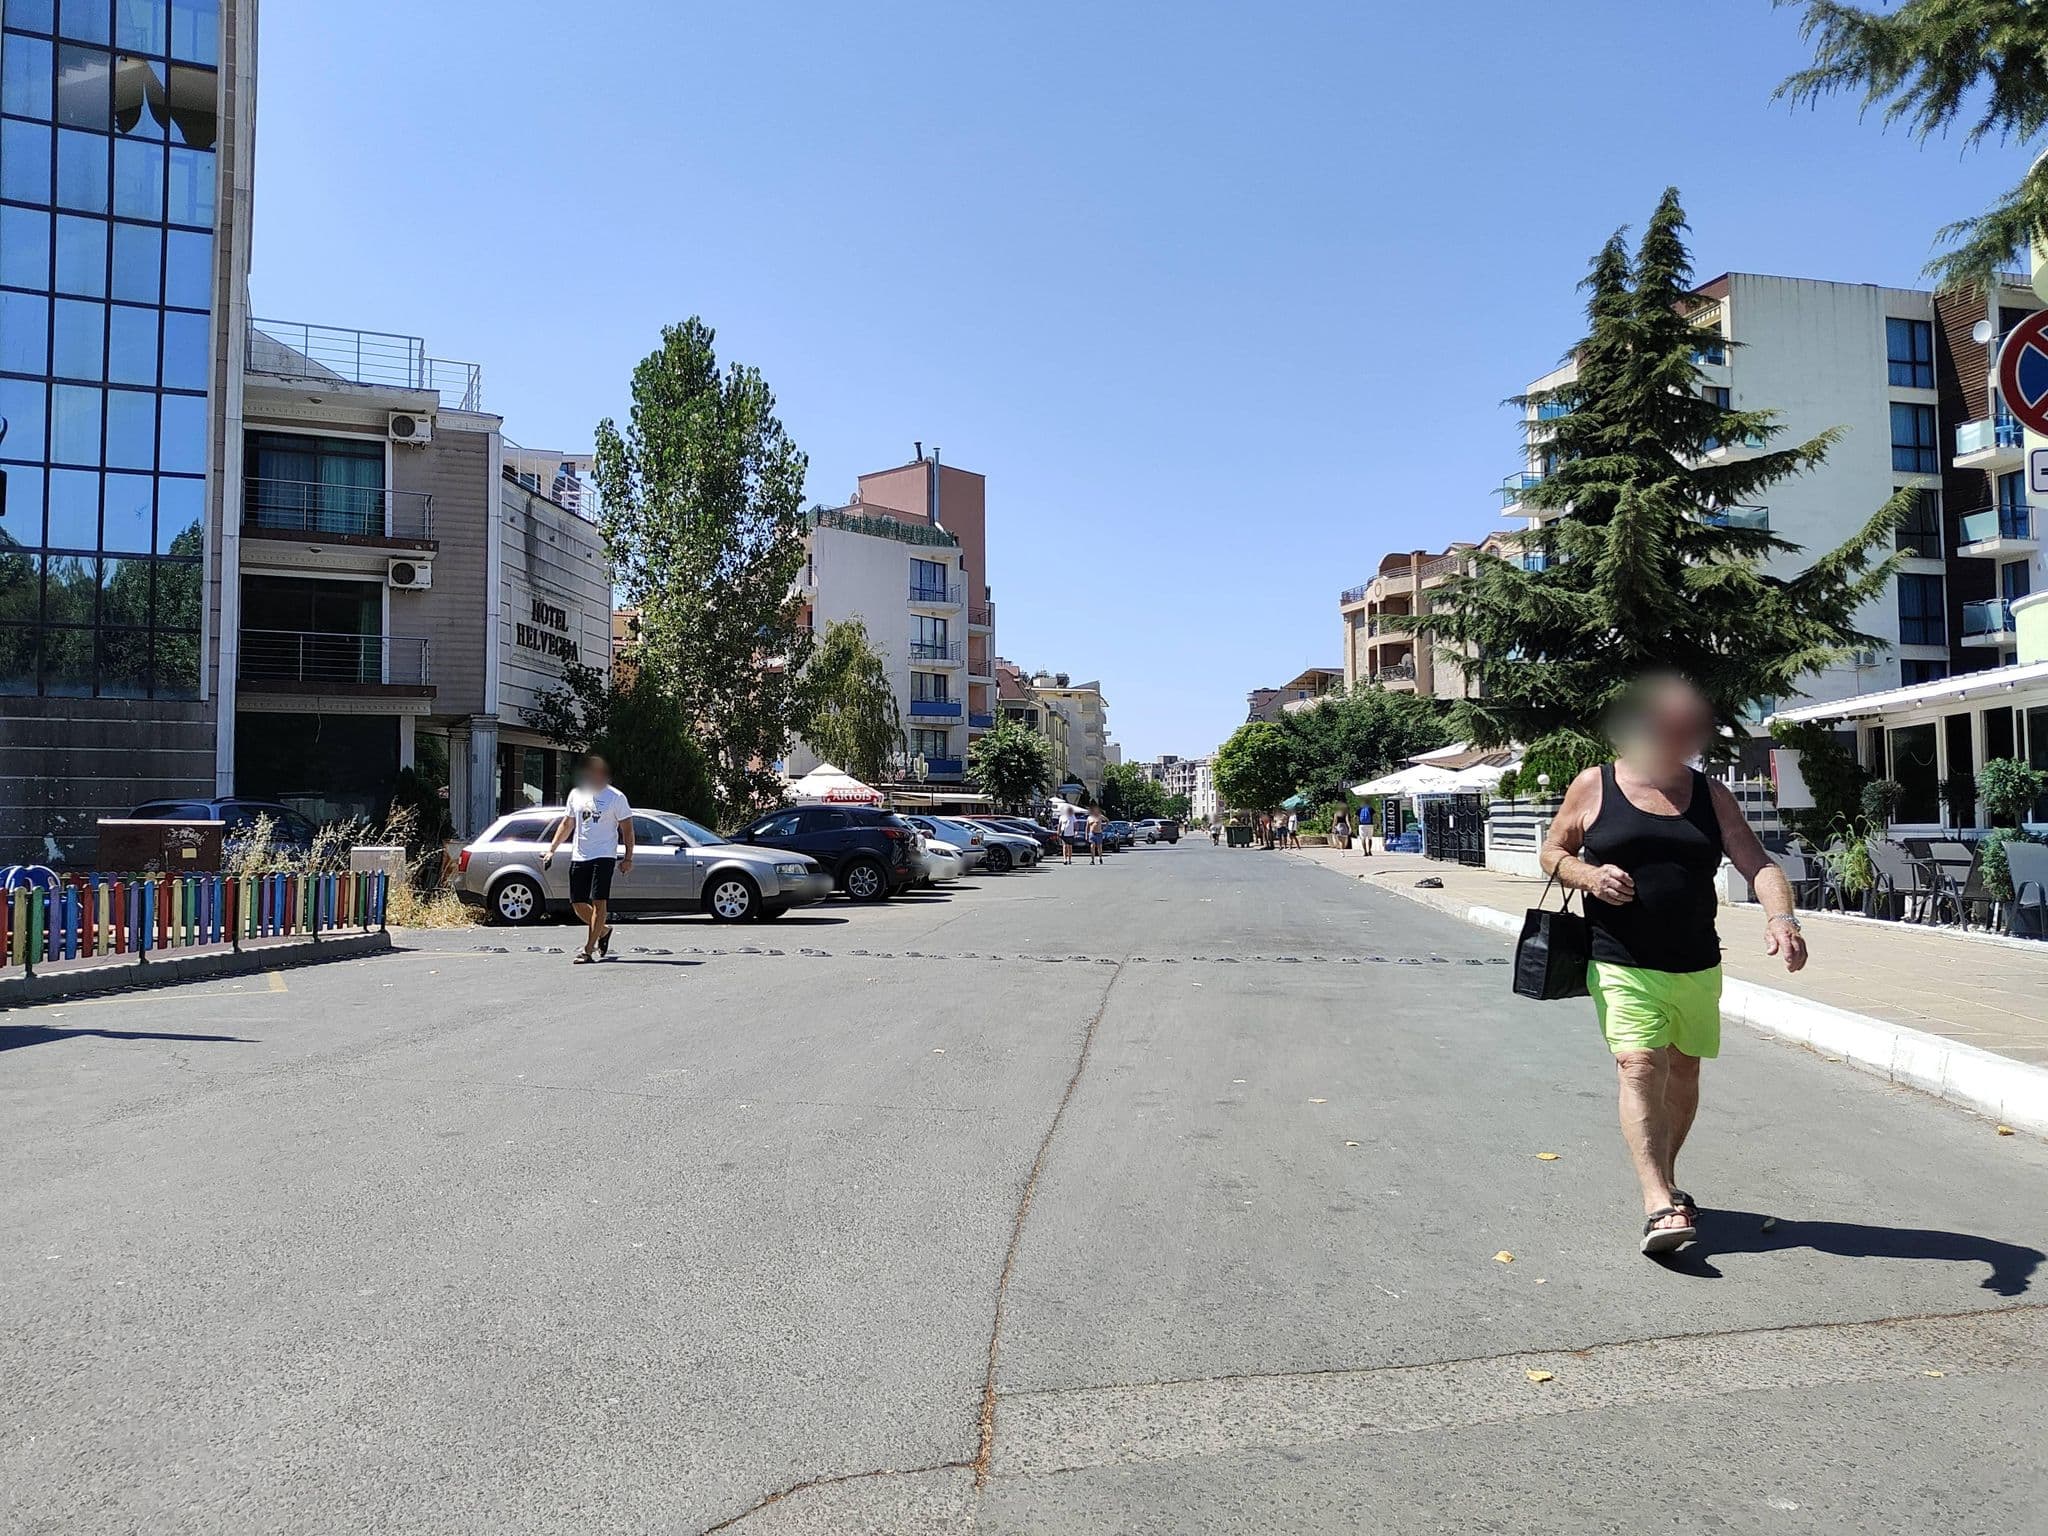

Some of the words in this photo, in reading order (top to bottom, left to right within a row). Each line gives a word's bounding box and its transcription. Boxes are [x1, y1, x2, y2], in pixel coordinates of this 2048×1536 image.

[531, 599, 569, 632] HOTEL
[833, 793, 871, 801] ARTOIS
[1386, 801, 1396, 838] COFFEE
